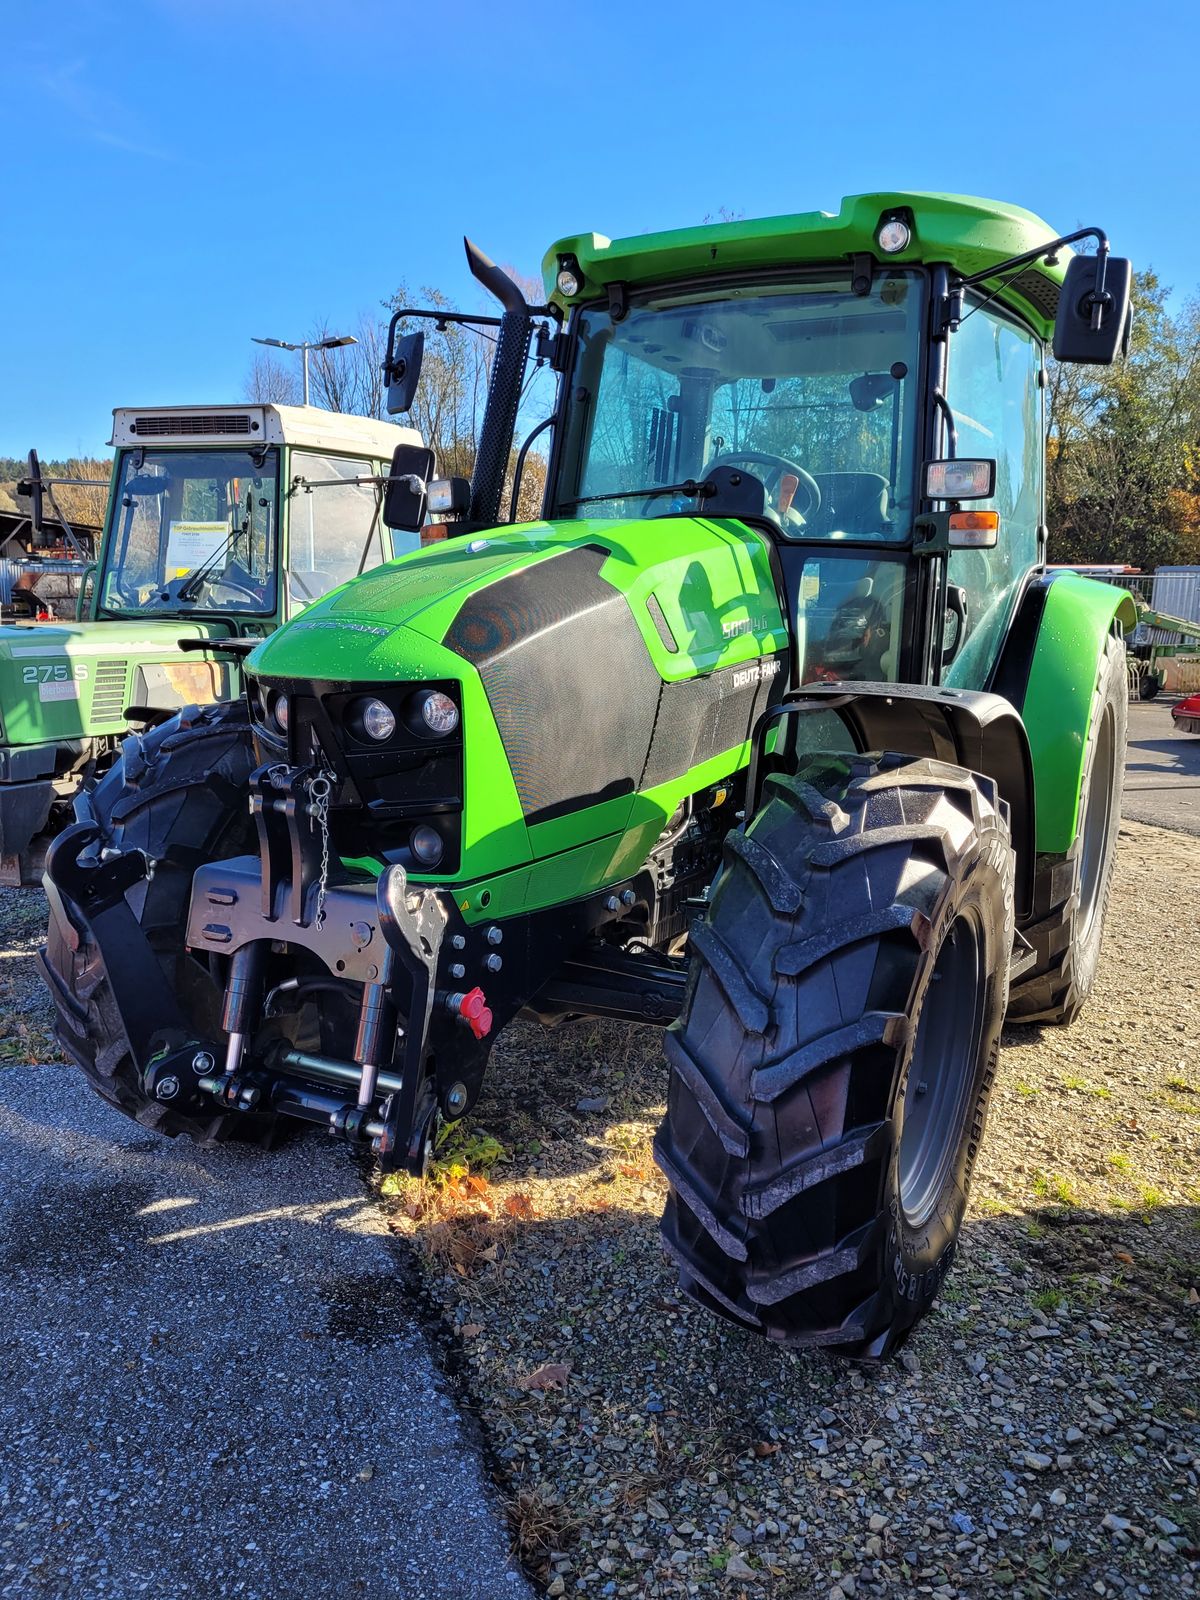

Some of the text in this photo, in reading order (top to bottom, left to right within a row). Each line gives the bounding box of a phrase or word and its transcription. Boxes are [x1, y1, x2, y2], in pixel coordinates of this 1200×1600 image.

[22, 664, 89, 684] 275 S
[733, 660, 781, 688] DEUTZ-FAHR
